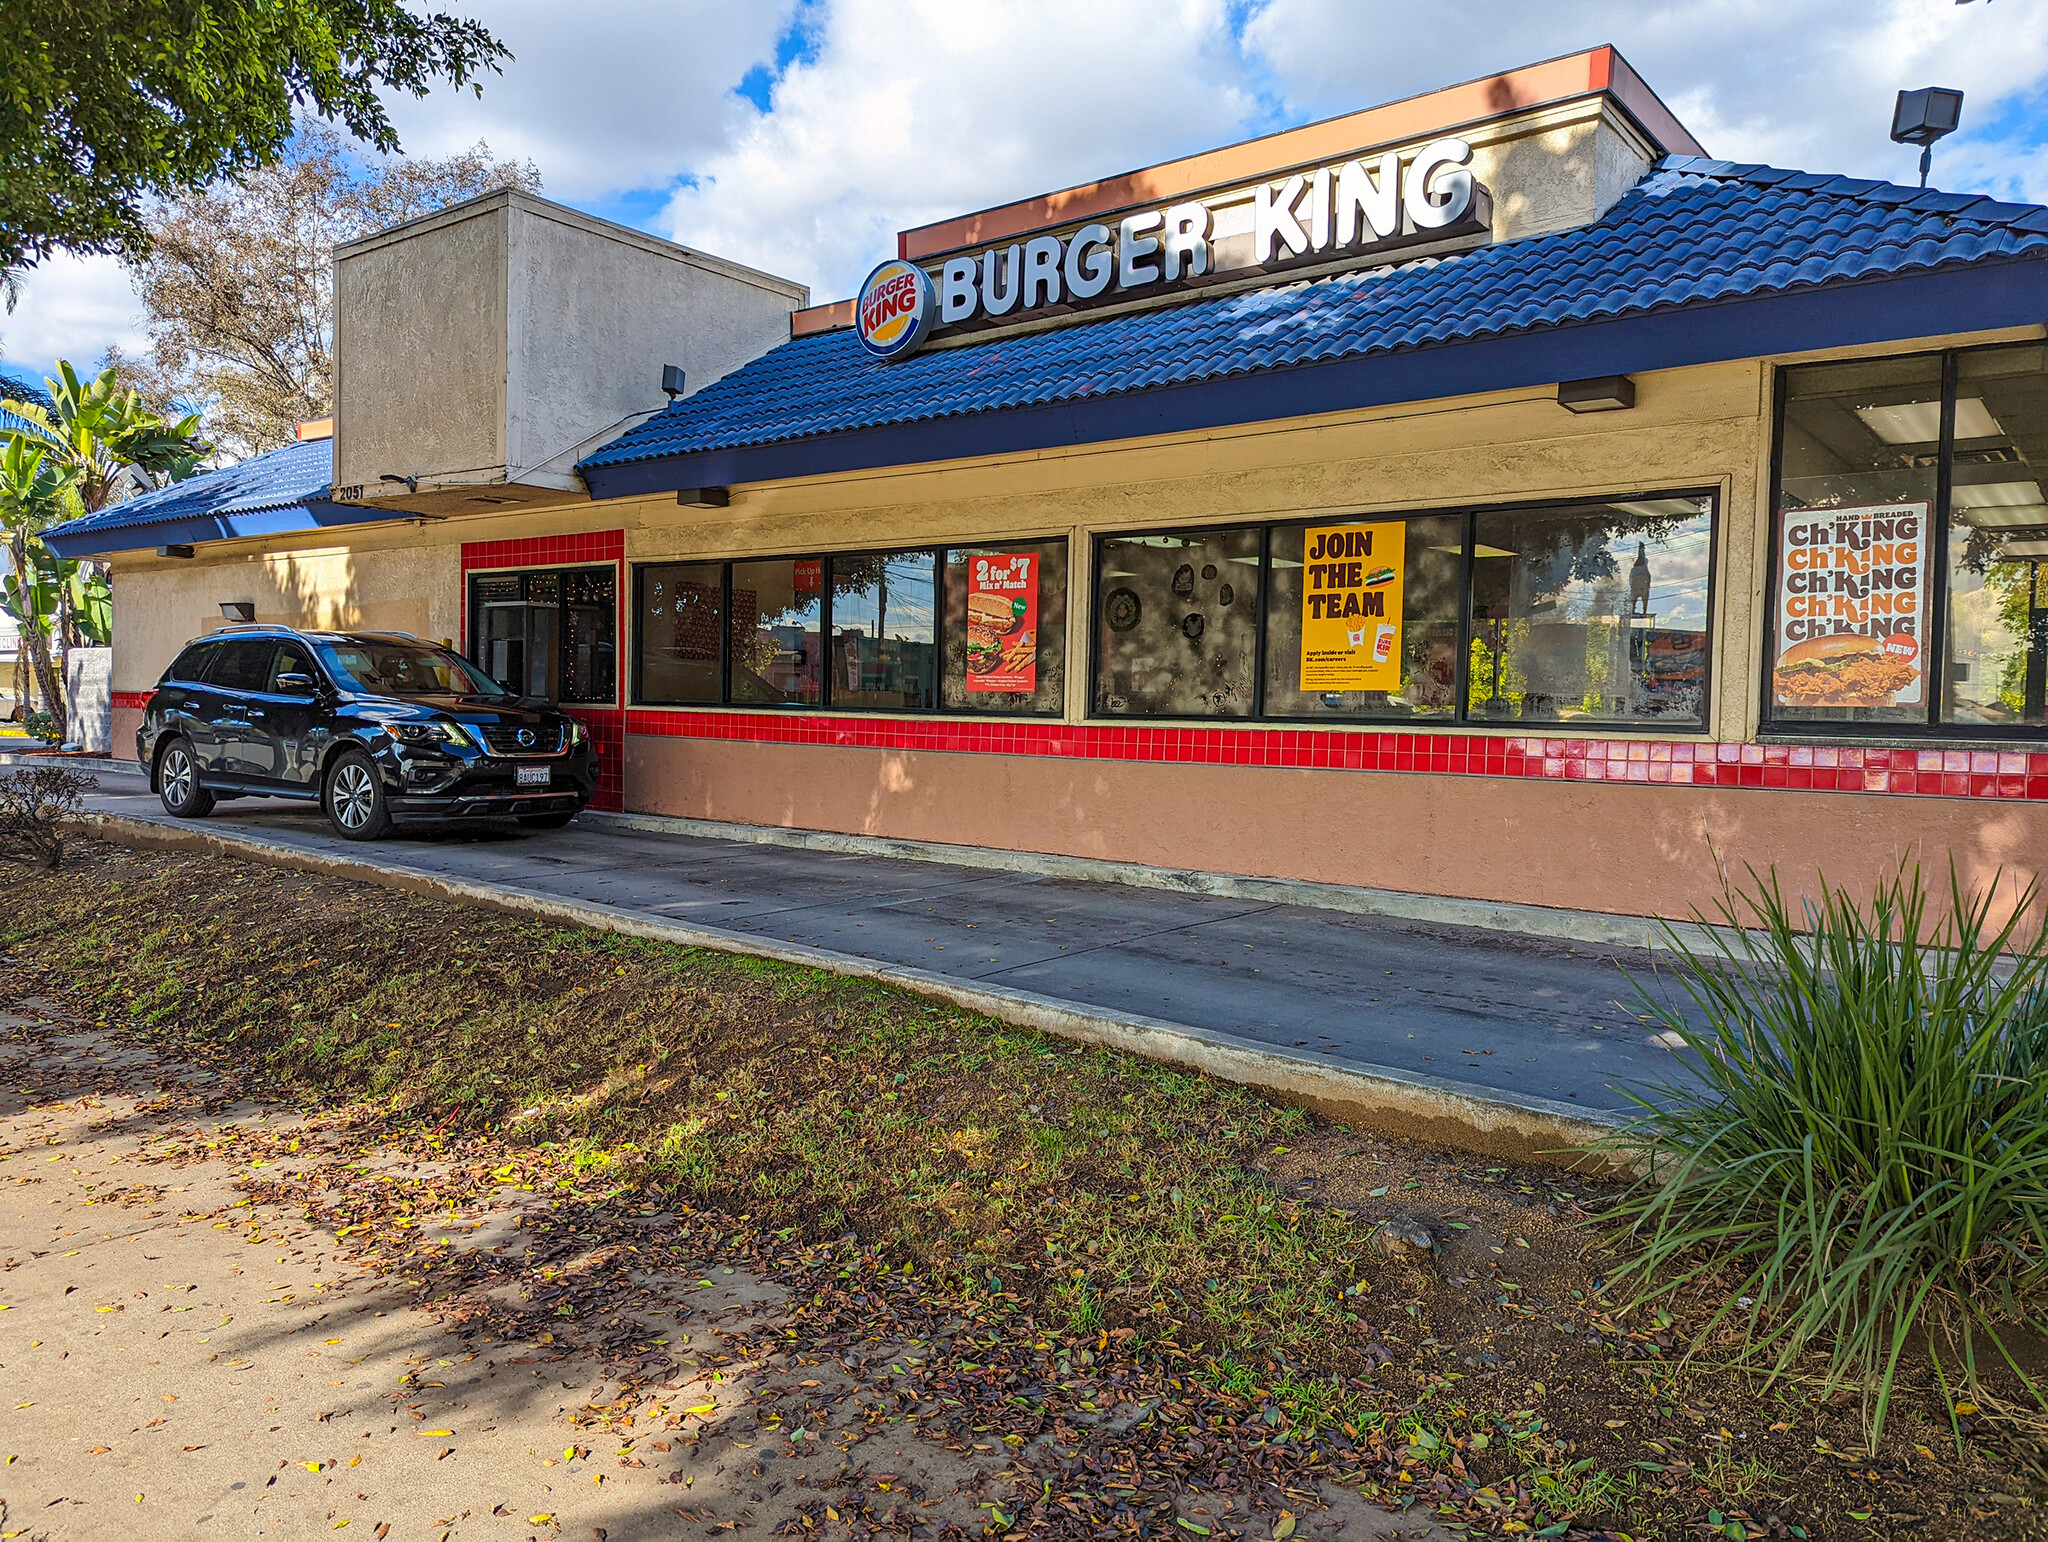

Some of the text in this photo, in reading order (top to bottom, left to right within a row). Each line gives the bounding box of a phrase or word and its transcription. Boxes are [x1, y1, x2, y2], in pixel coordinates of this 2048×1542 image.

[942, 138, 1473, 324] BURGER KING
[862, 273, 915, 315] BURGER
[864, 288, 916, 338] KING
[340, 485, 364, 500] 2051
[1836, 510, 1914, 522] HAND BREADED
[1309, 531, 1373, 559] JOIN
[795, 567, 815, 576] Pick-Up
[976, 557, 1030, 581] 2 for $7
[1309, 562, 1362, 589] THE
[980, 582, 994, 590] Mix
[1003, 580, 1027, 589] Match
[1013, 602, 1026, 610] New
[1308, 592, 1384, 619] TEAM
[1886, 643, 1916, 656] NEW
